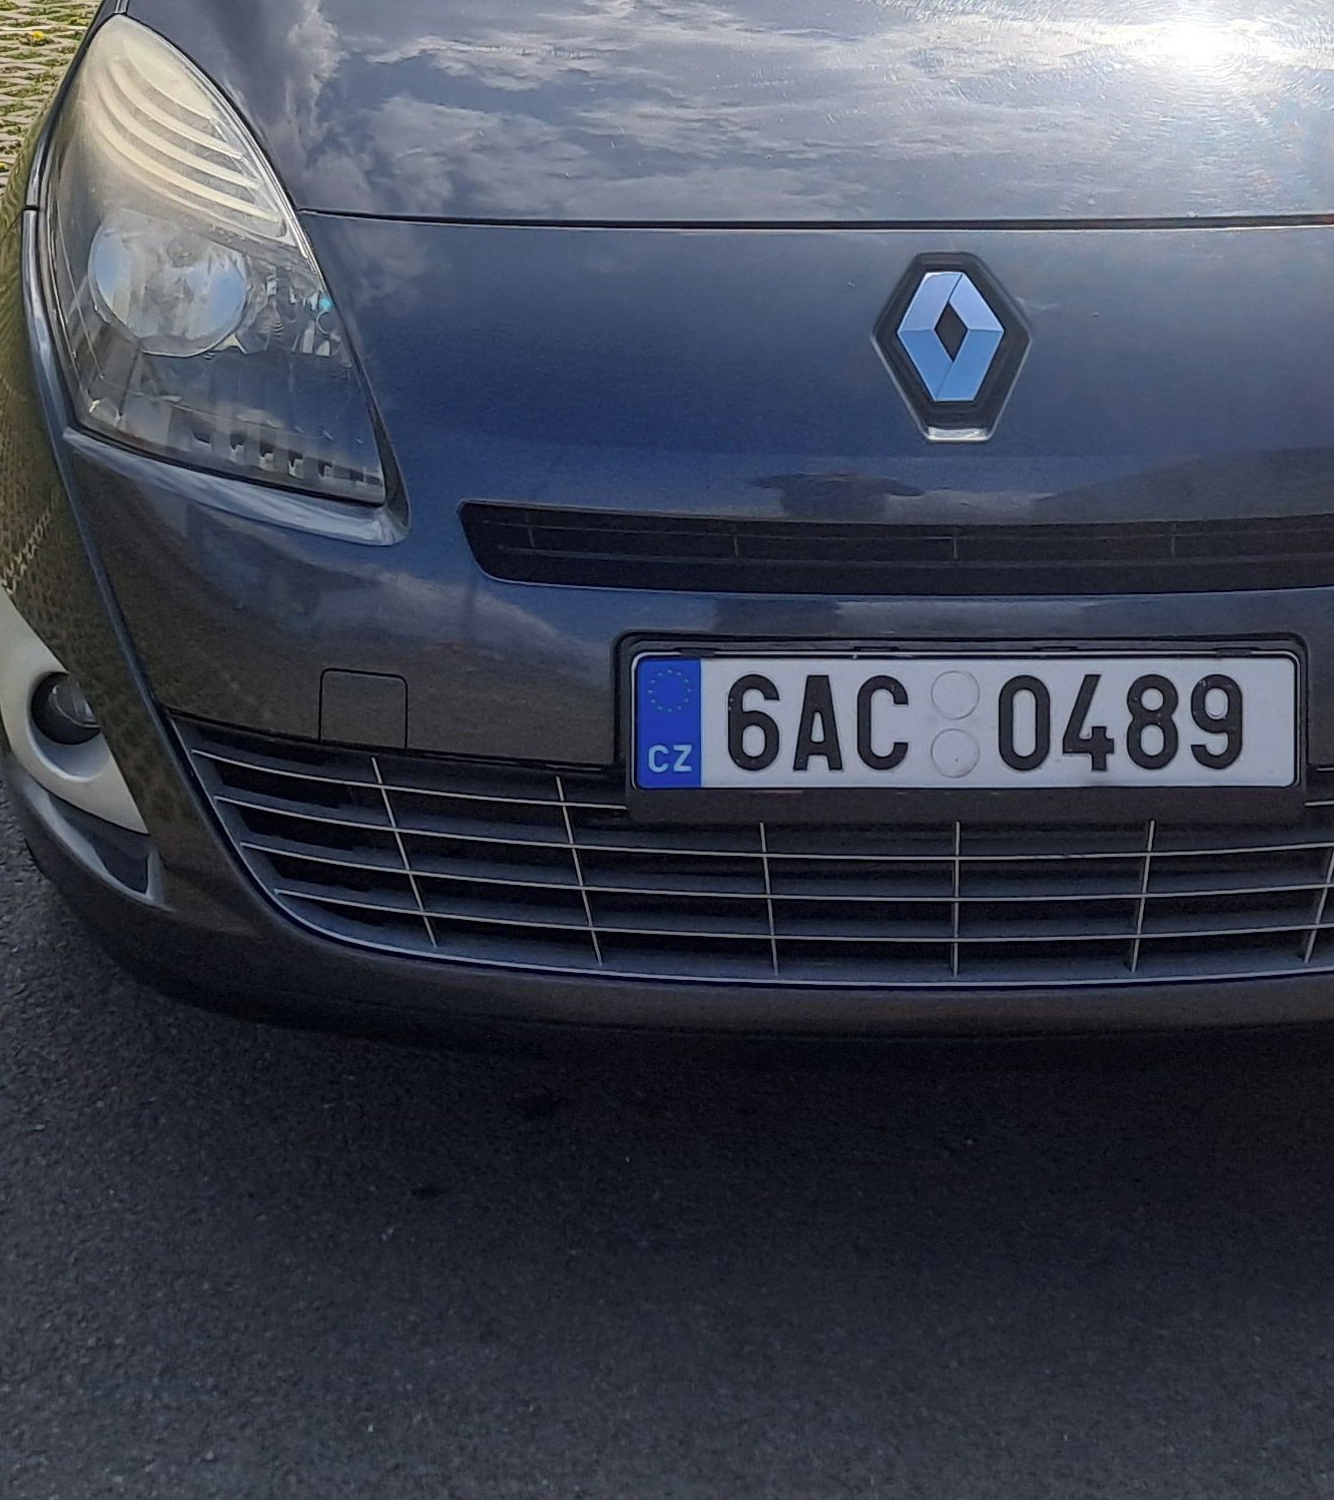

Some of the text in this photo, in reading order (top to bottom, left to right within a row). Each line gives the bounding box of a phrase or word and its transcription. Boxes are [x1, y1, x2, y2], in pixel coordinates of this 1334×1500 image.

[727, 673, 1244, 772] 6AC 0489
[647, 743, 693, 773] CZ
